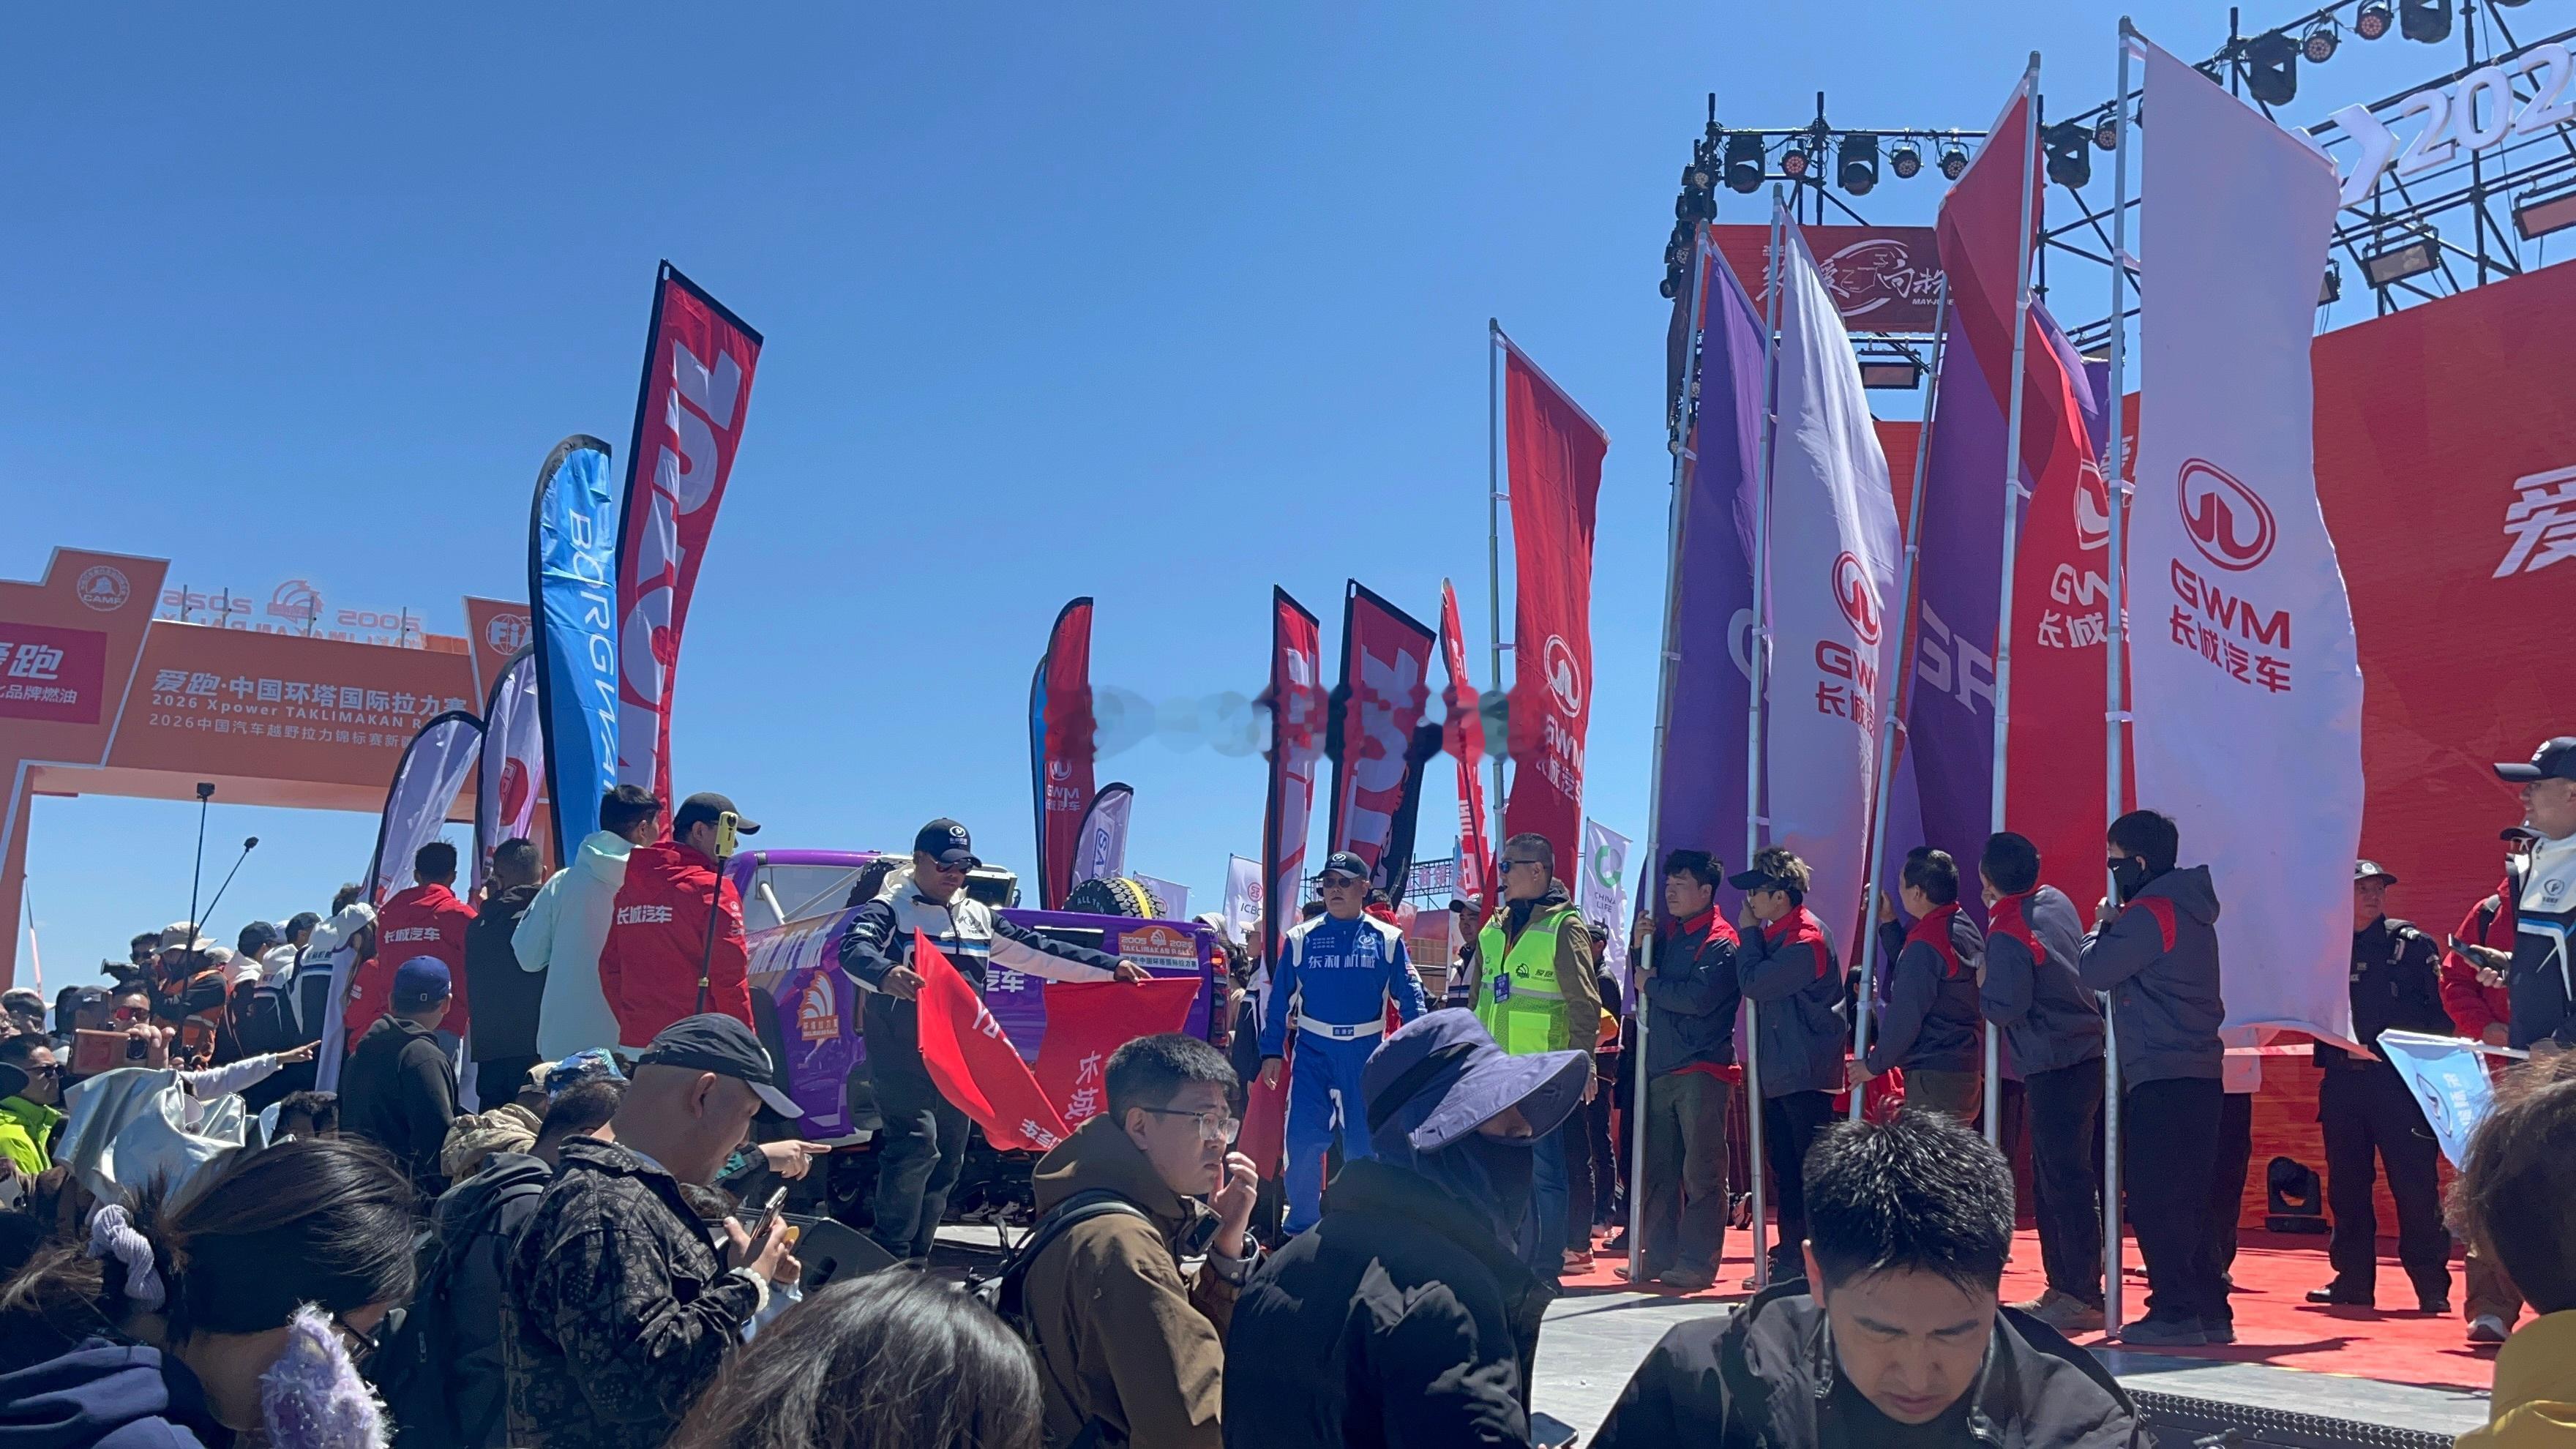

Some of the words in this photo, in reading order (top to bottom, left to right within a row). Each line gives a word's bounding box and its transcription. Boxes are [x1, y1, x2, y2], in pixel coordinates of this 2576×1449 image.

[2051, 563, 2109, 607] GW
[2171, 558, 2290, 650] GWM
[568, 506, 618, 792] BORGWA
[2037, 609, 2128, 648] 长城
[2169, 604, 2291, 693] 长城汽车
[1816, 640, 1876, 694] GW
[152, 694, 198, 708] 2026
[207, 698, 277, 716] Xpower
[285, 705, 403, 728] TAKLIMAKAN
[616, 905, 673, 924] 长城汽车
[1596, 902, 1612, 913] LIFE
[383, 926, 441, 943] 长城汽车
